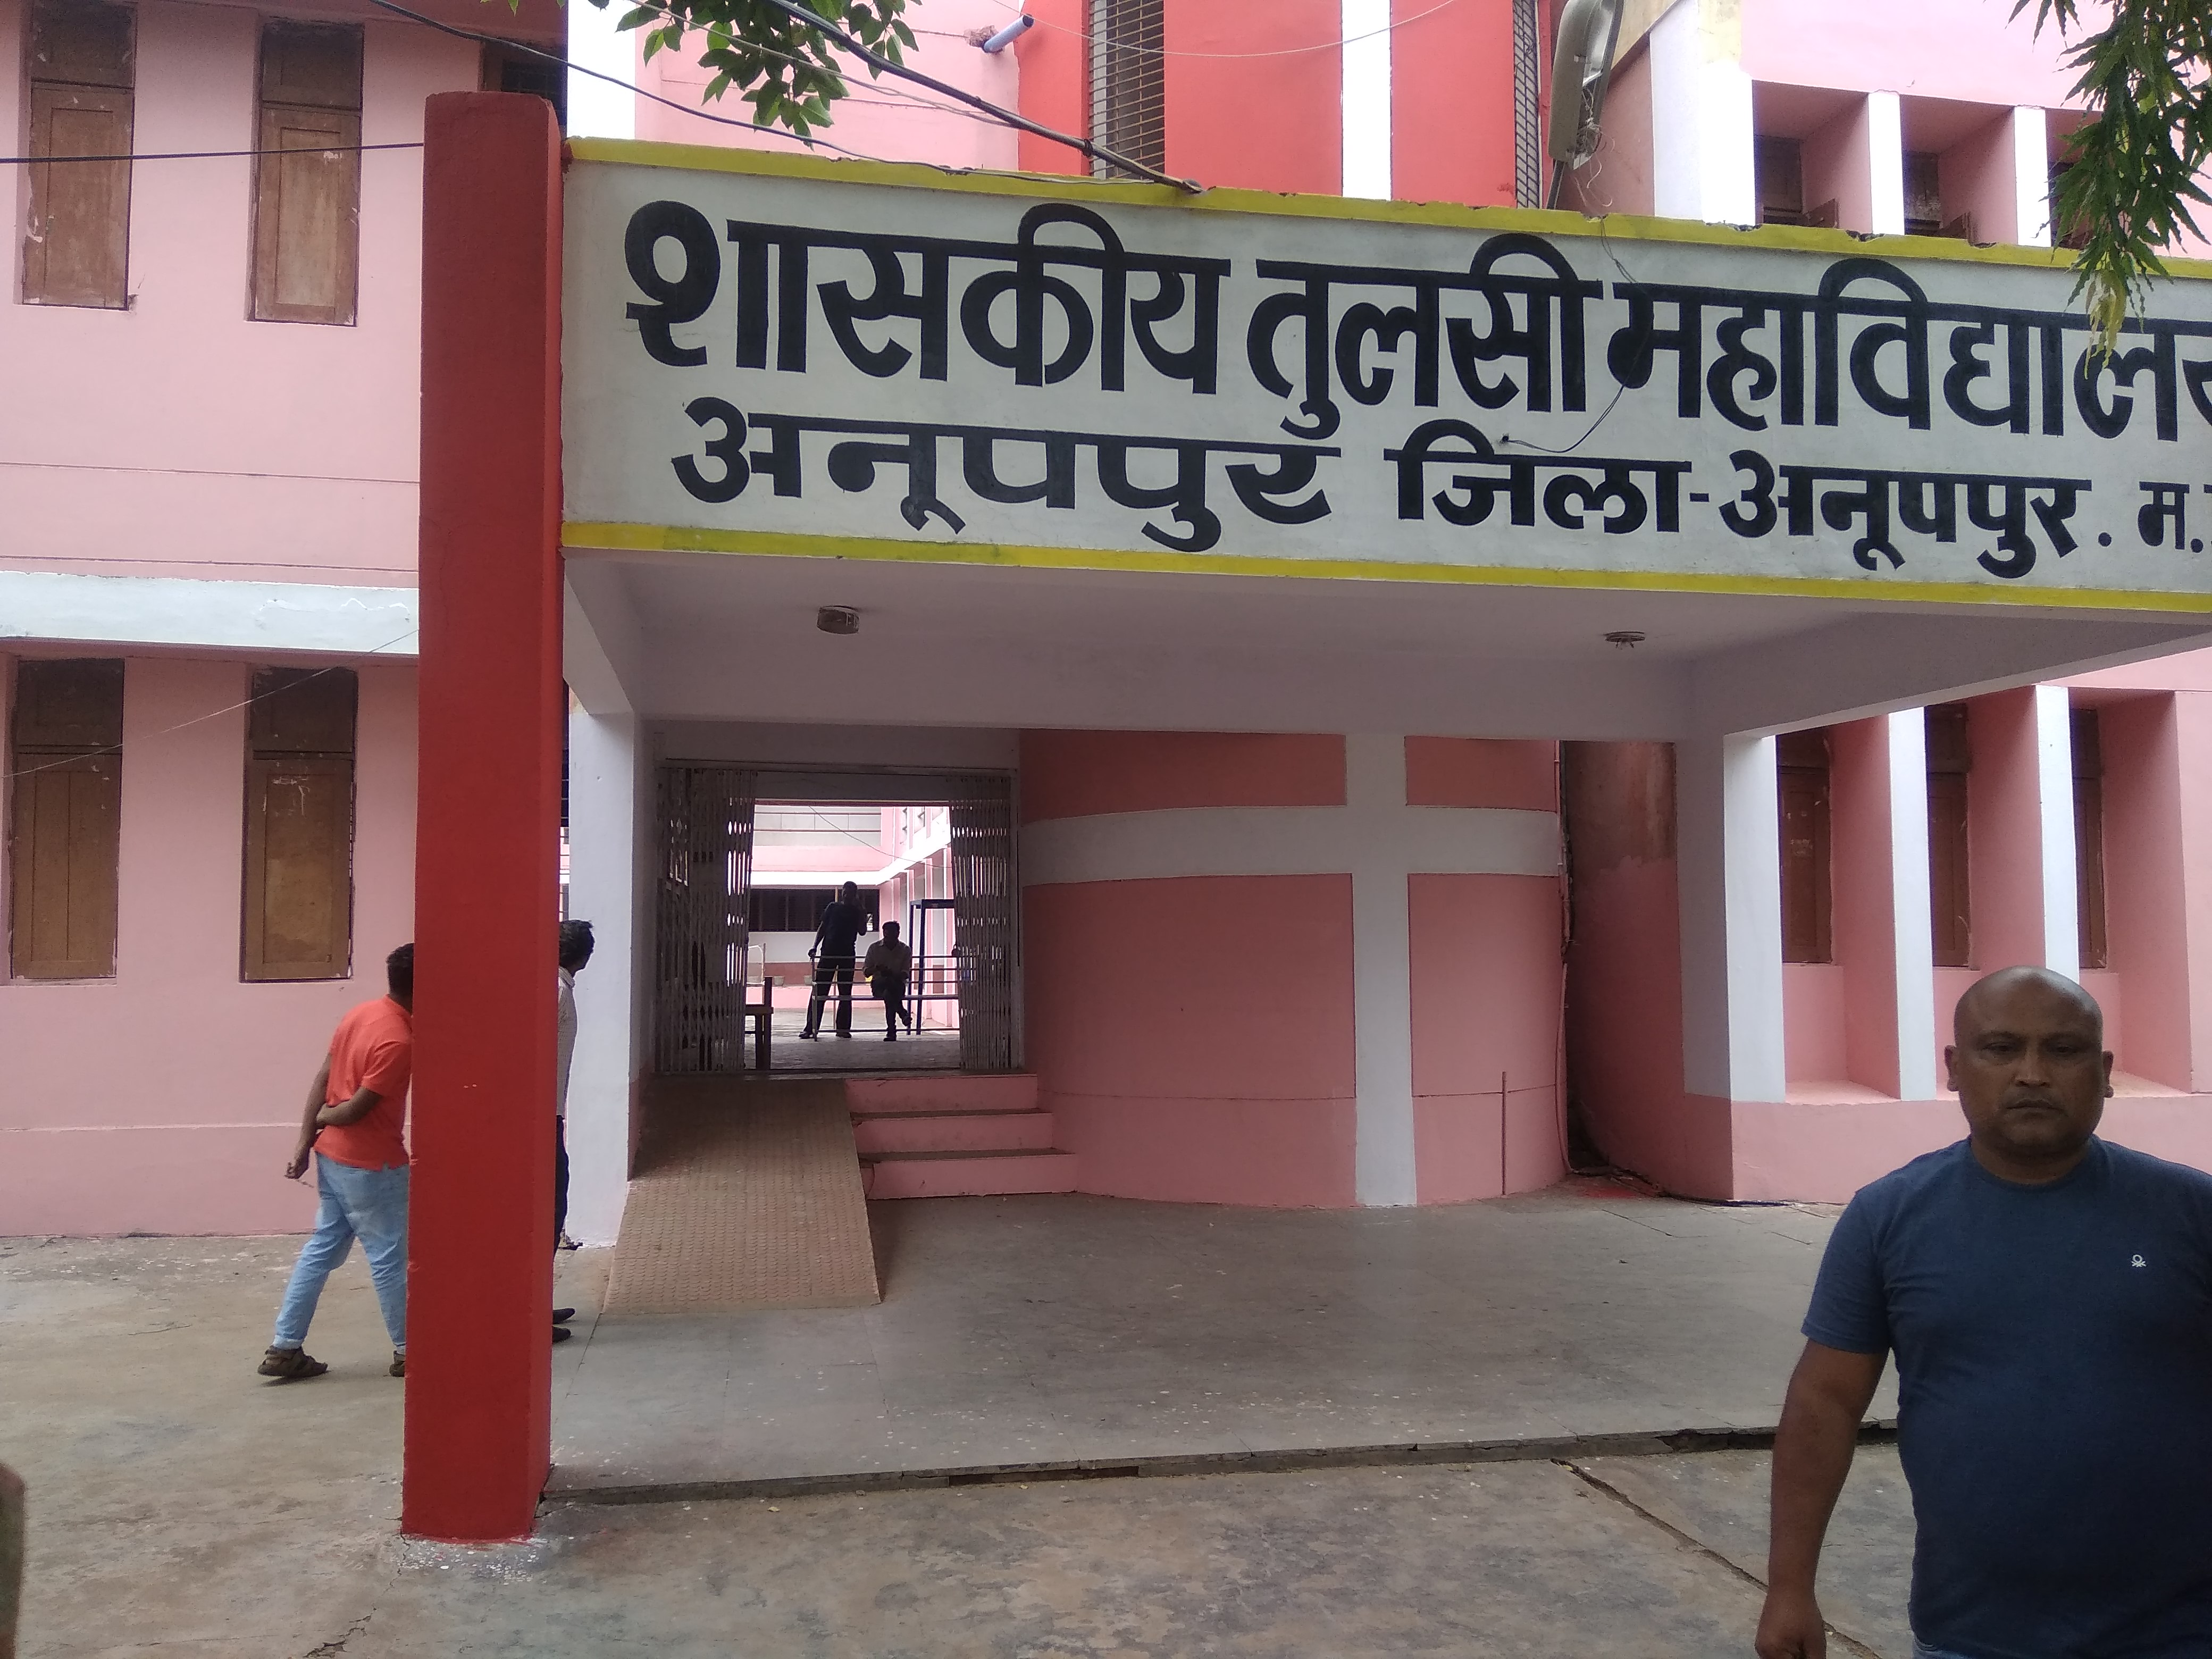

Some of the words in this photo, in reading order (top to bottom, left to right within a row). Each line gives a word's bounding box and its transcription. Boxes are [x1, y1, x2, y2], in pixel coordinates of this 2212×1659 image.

[624, 199, 1232, 396] शासकीय
[1246, 232, 1604, 441] तुलसी
[669, 396, 1342, 553] अनूपपुर
